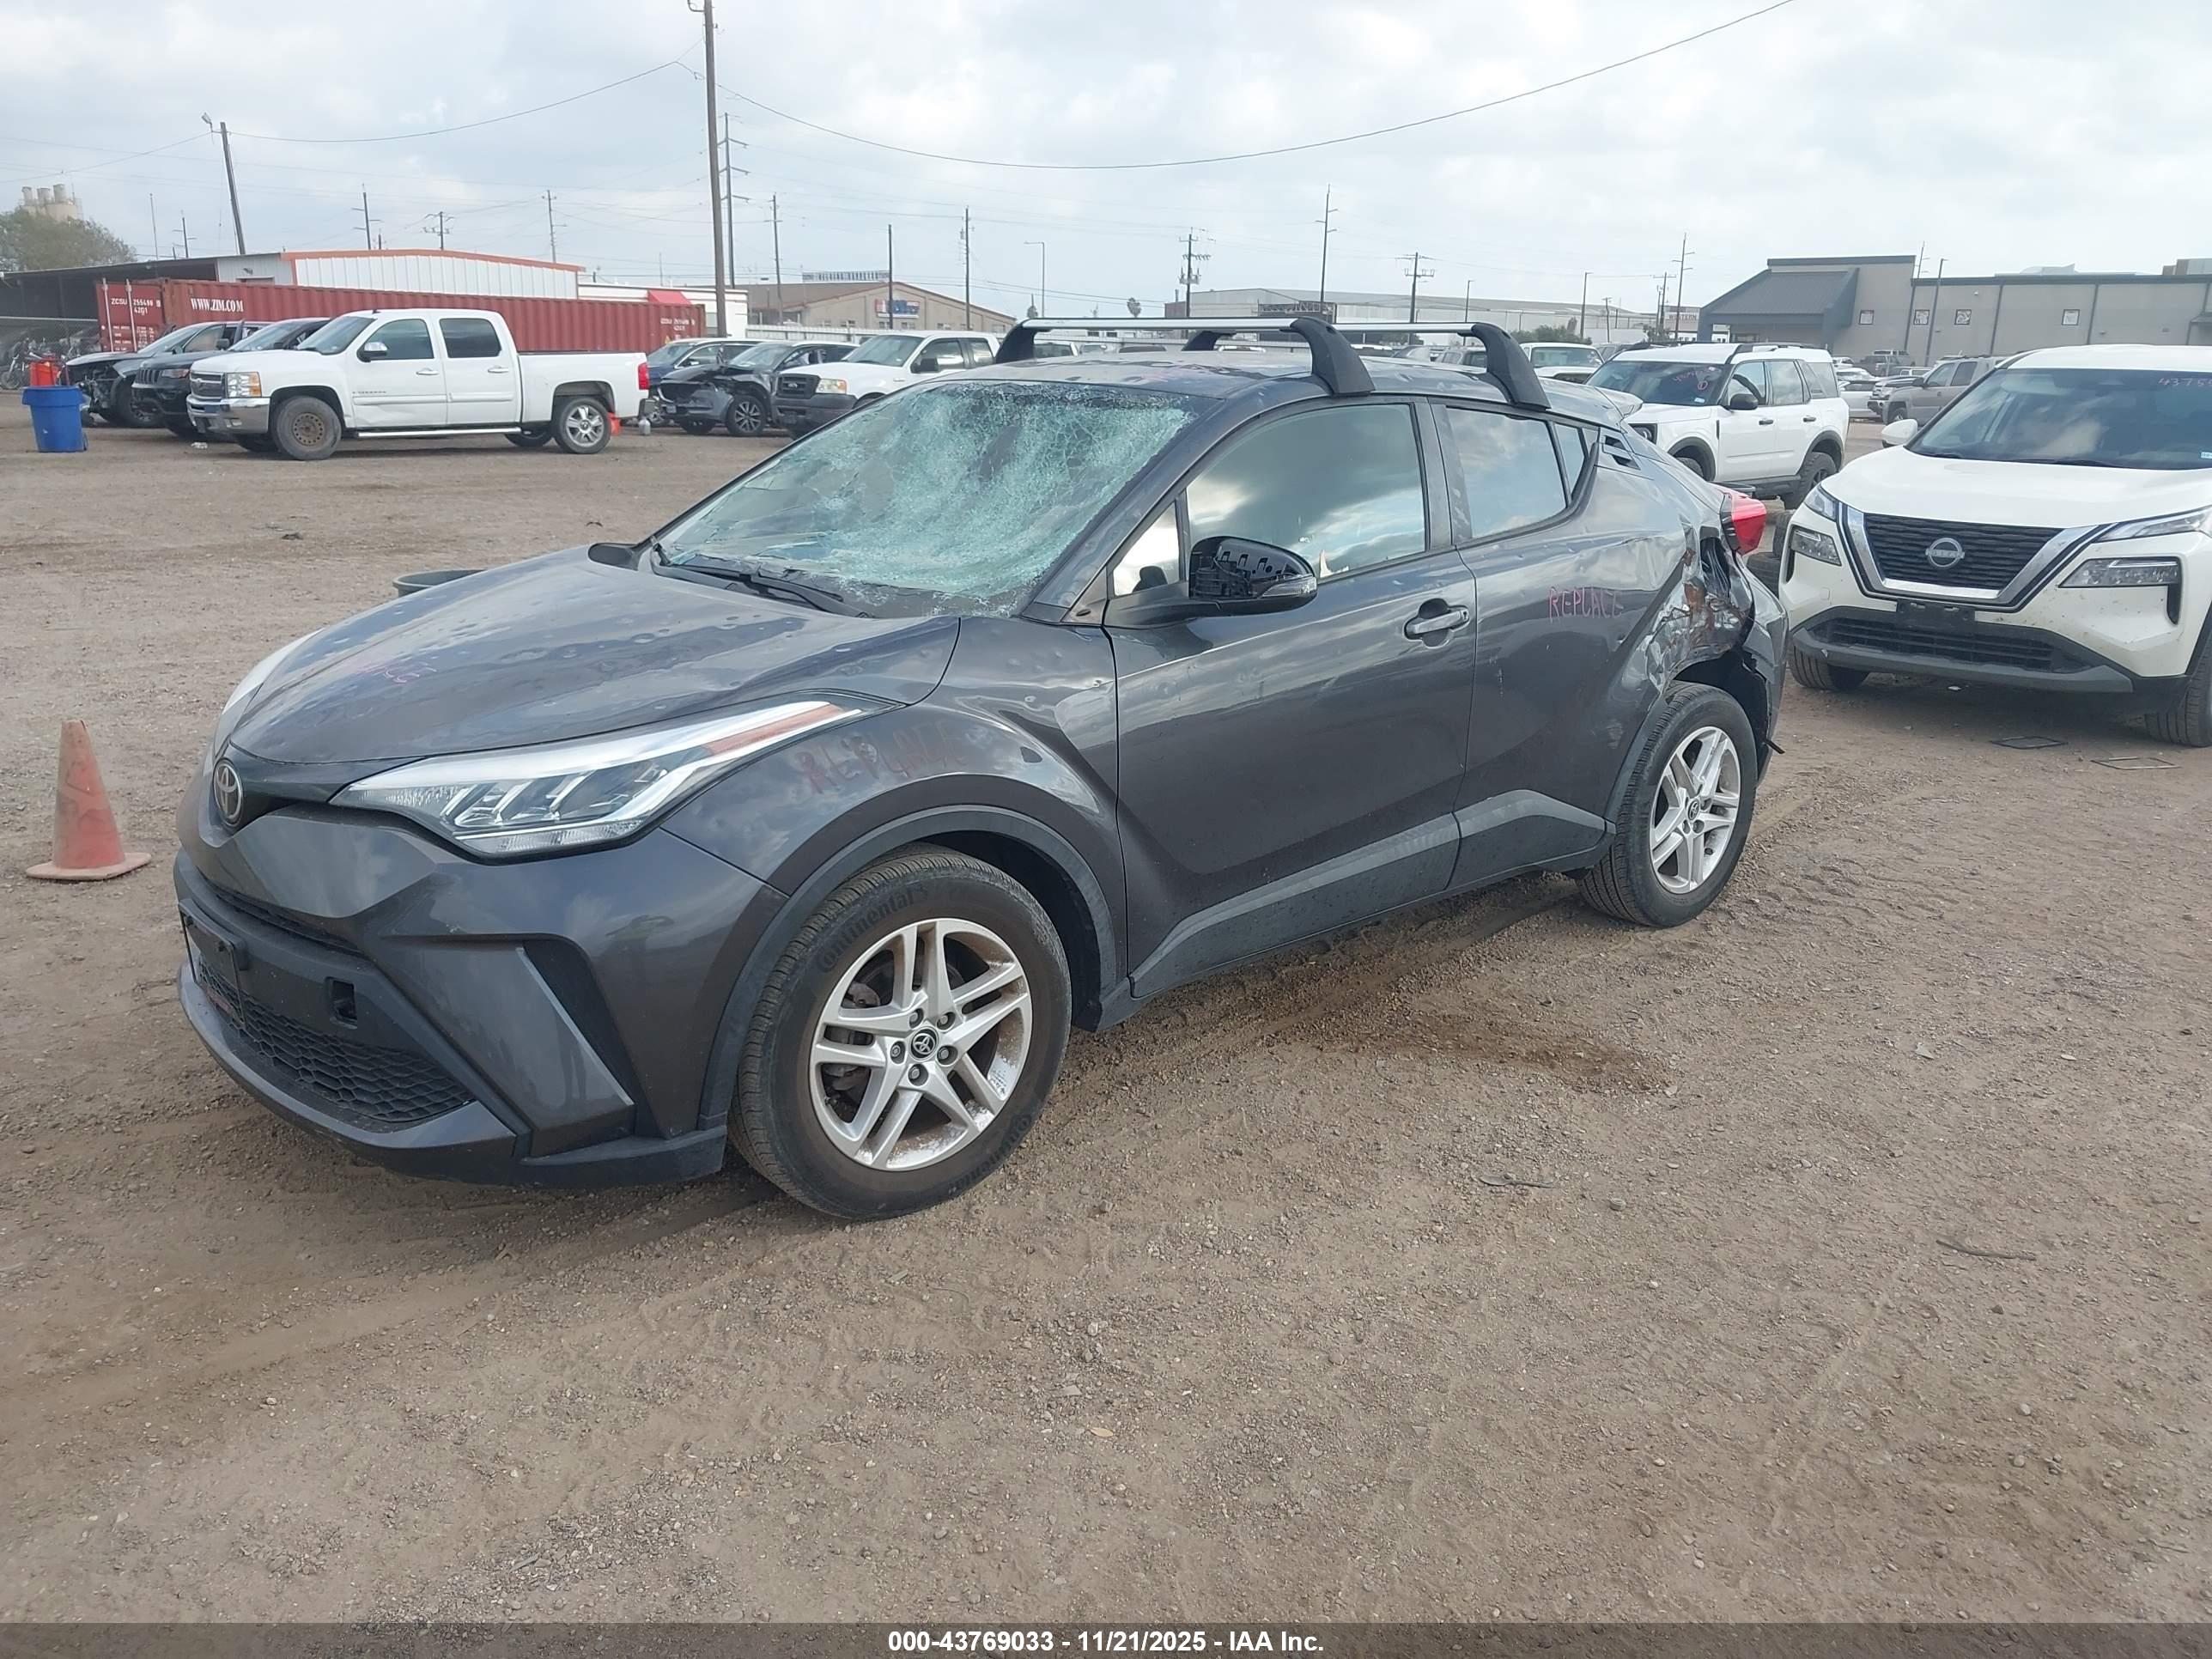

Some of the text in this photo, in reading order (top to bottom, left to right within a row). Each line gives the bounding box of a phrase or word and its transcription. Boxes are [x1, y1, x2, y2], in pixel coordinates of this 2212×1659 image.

[191, 298, 243, 312] WWW.ZIM.COM
[1549, 586, 1625, 623] REPLACE
[817, 890, 915, 974] Continental
